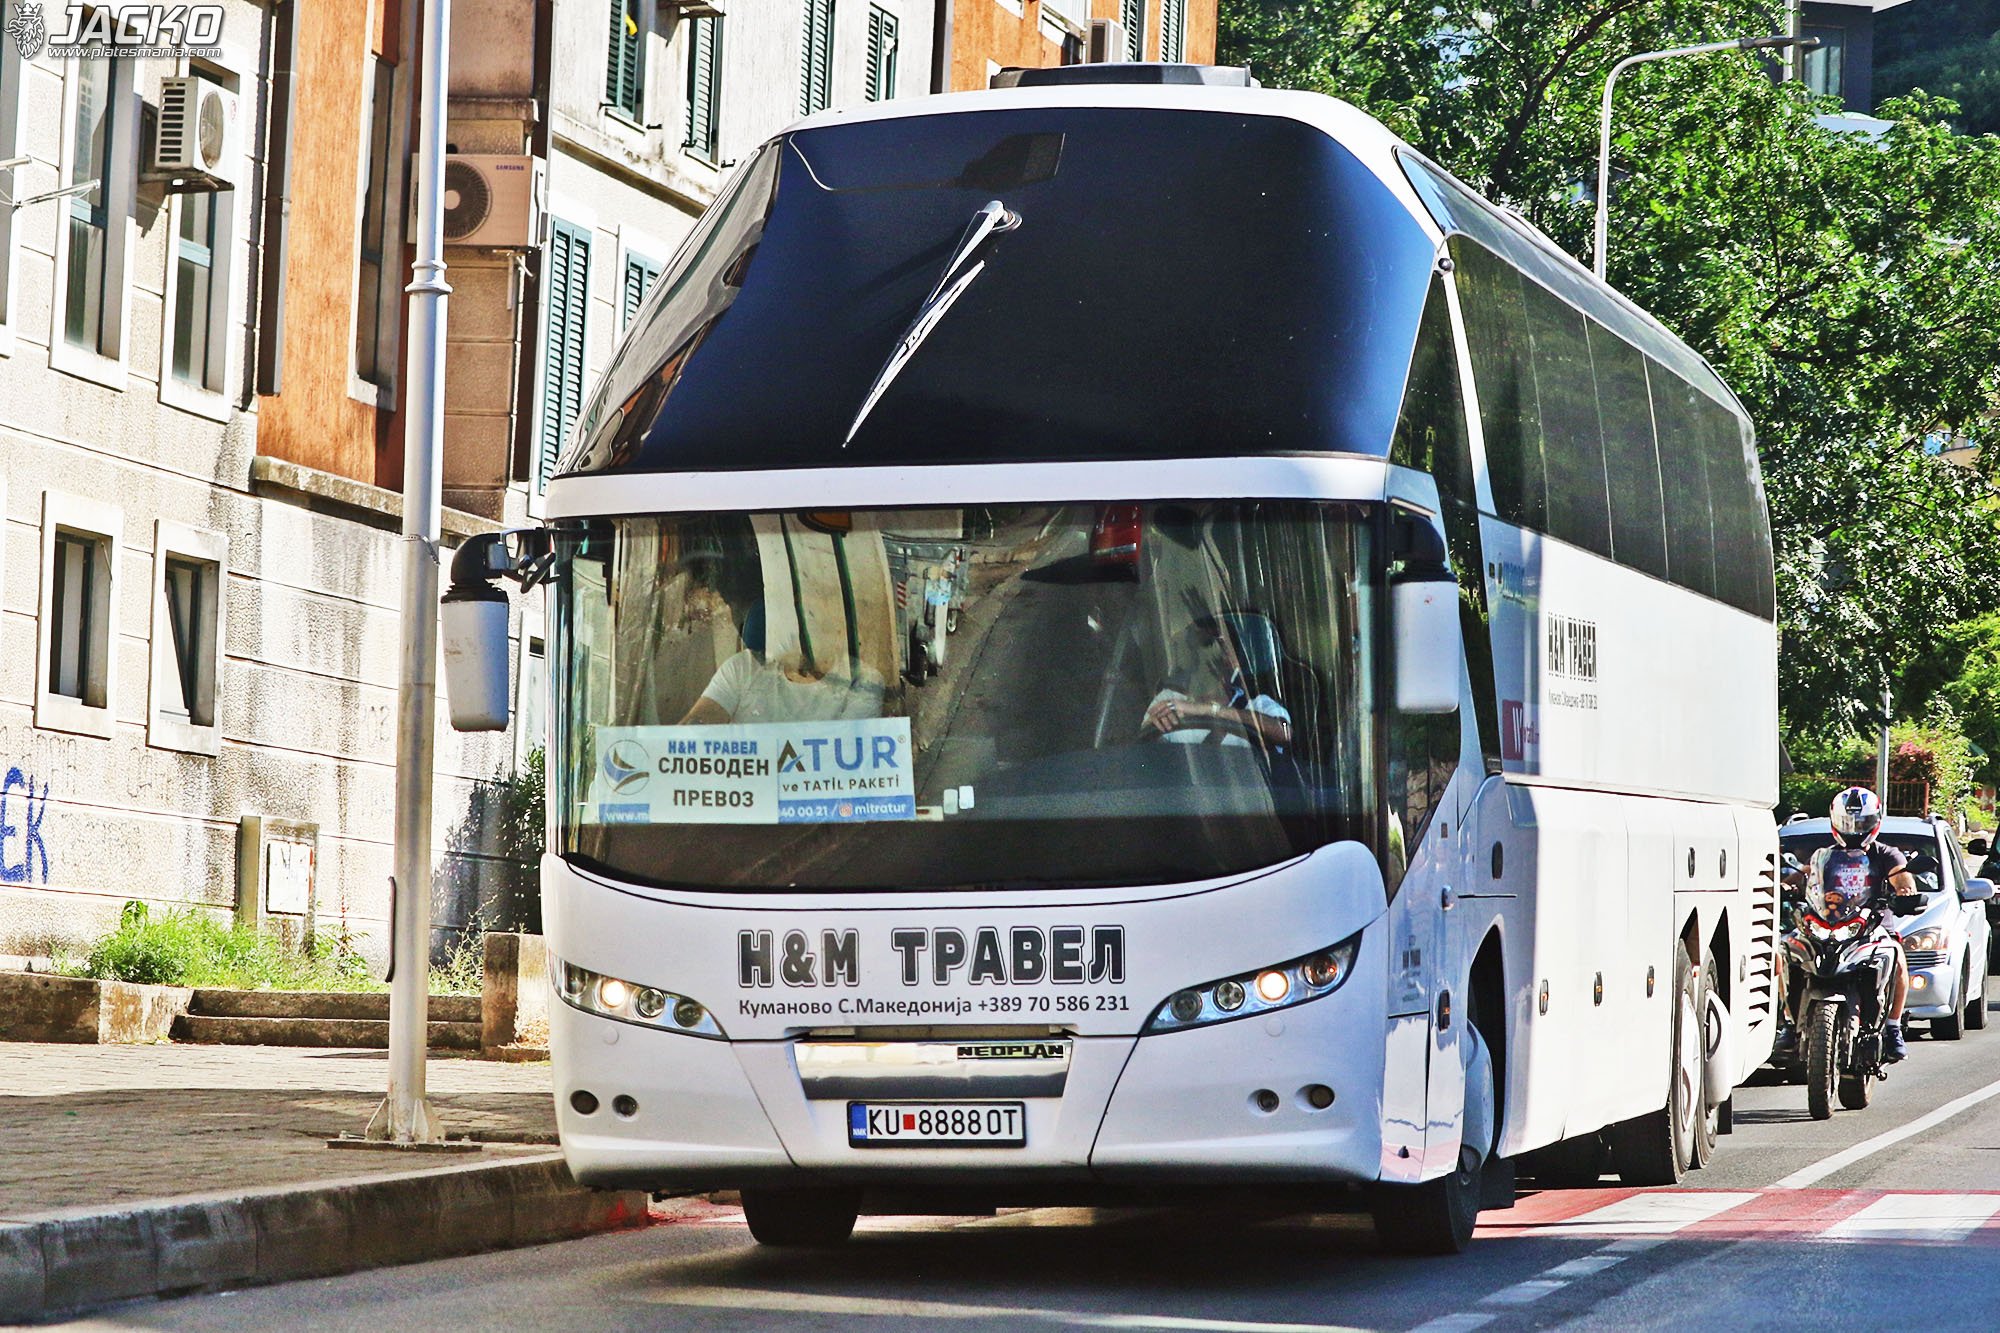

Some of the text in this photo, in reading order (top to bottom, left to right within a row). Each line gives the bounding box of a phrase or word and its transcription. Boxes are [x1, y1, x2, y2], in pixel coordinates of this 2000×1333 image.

[704, 741, 758, 755] ТРАВЕЛ
[658, 757, 769, 778] СЛОБОДЕН
[782, 774, 899, 792] ve TATİL PAKETİ
[673, 789, 754, 808] ПРЕВОЗ
[797, 806, 814, 818] 00
[815, 805, 828, 817] 21
[855, 802, 907, 816] mitratur
[891, 924, 1126, 987] ТРАВЕЛ
[739, 995, 1129, 1019] Куманово С.Македонија +389 70 586 231
[957, 1044, 1064, 1059] NEOPLAN
[869, 1109, 900, 1136] KU
